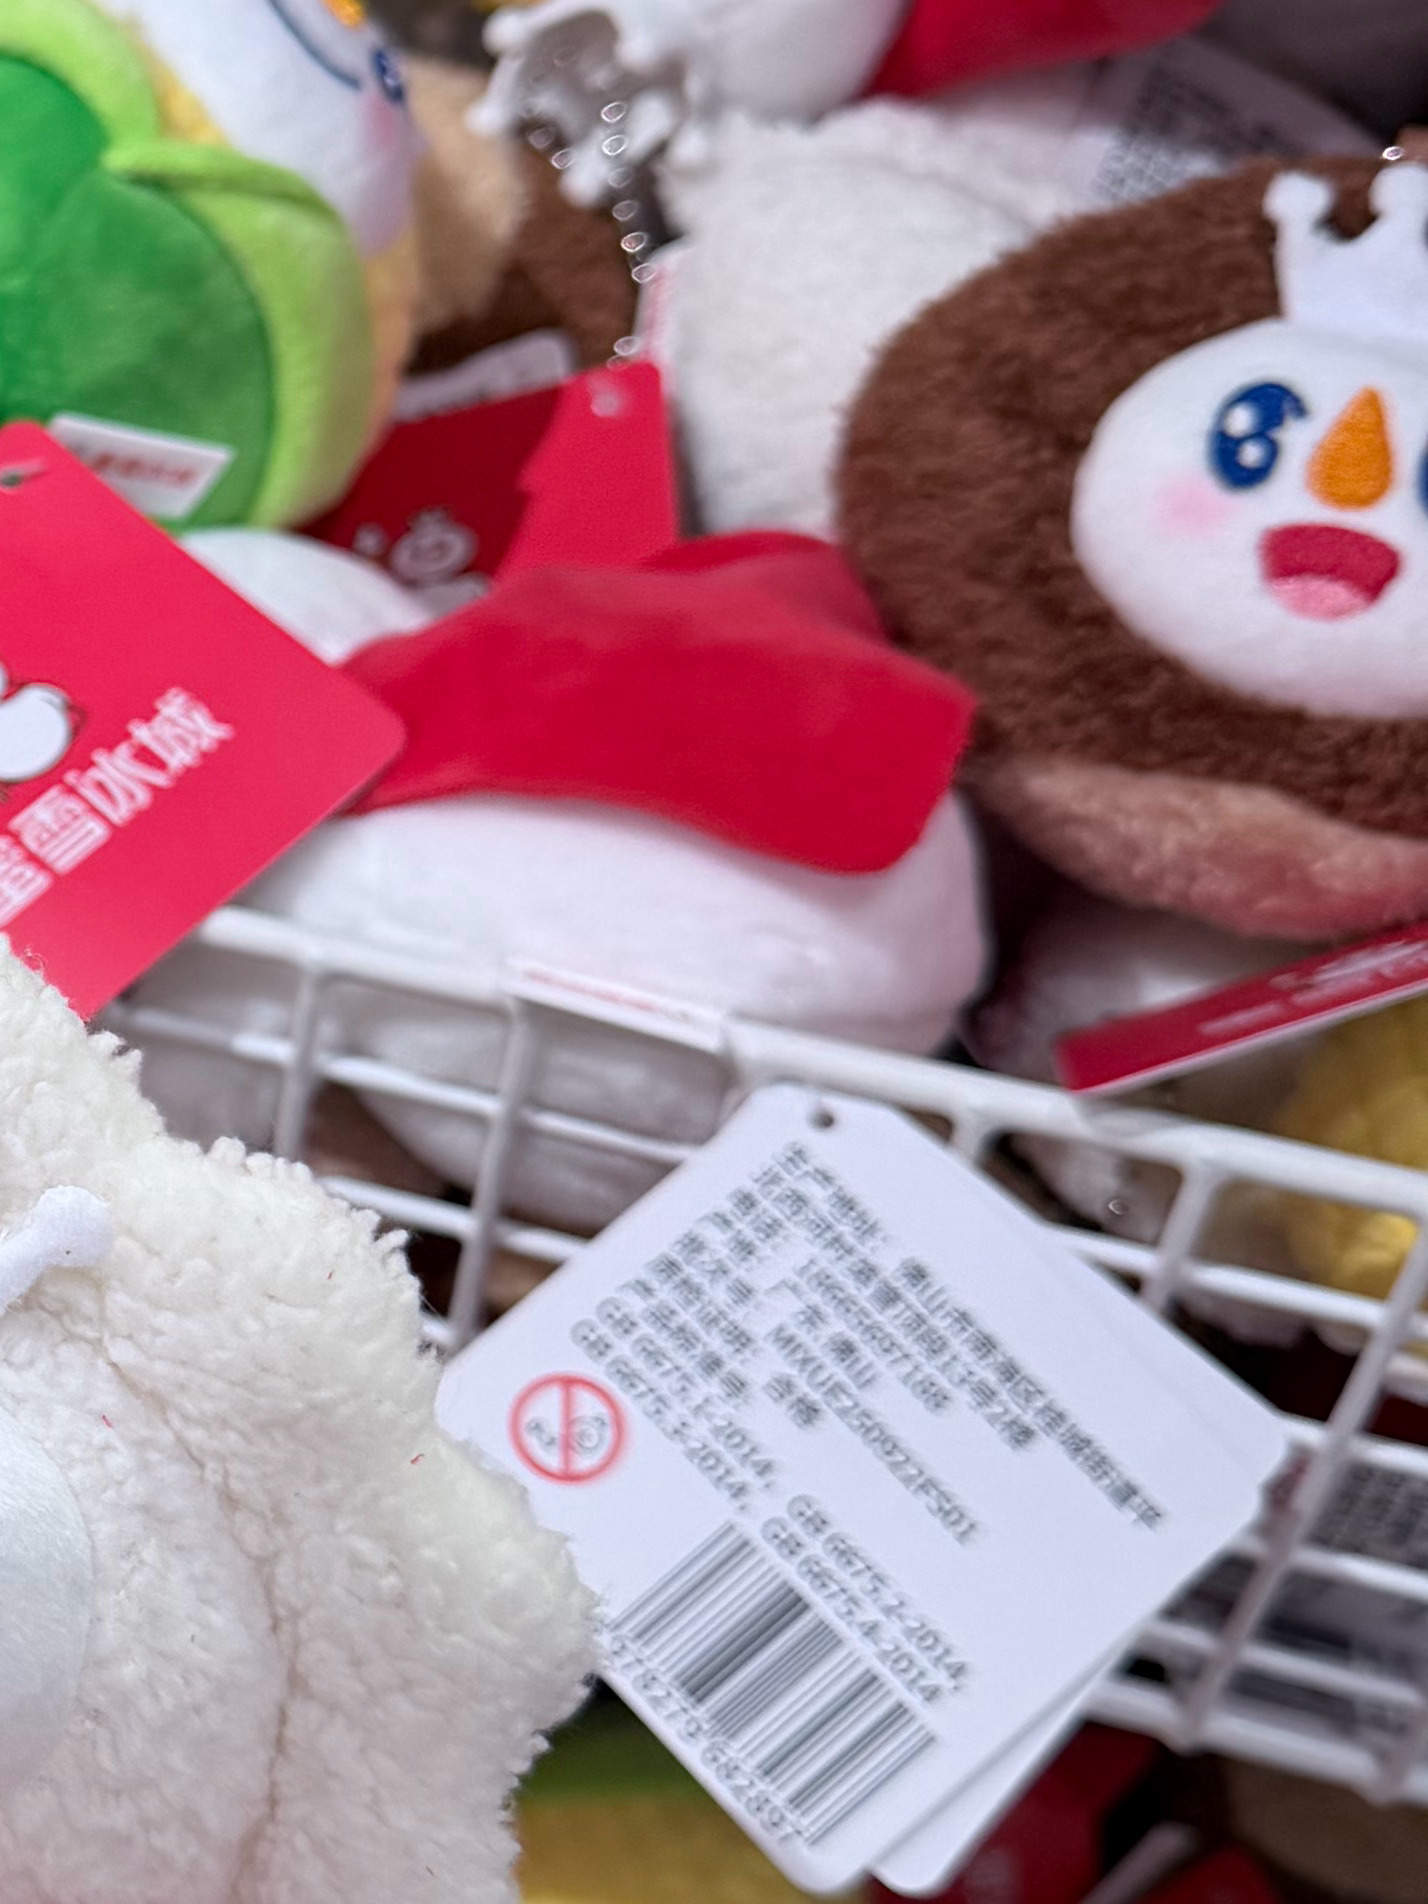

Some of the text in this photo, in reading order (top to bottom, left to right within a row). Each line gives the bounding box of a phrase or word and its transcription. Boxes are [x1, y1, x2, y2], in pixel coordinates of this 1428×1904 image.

[569, 1318, 615, 1363] GB
[760, 1515, 806, 1561] GB
[595, 1295, 641, 1340] GB
[786, 1491, 832, 1537] GB
